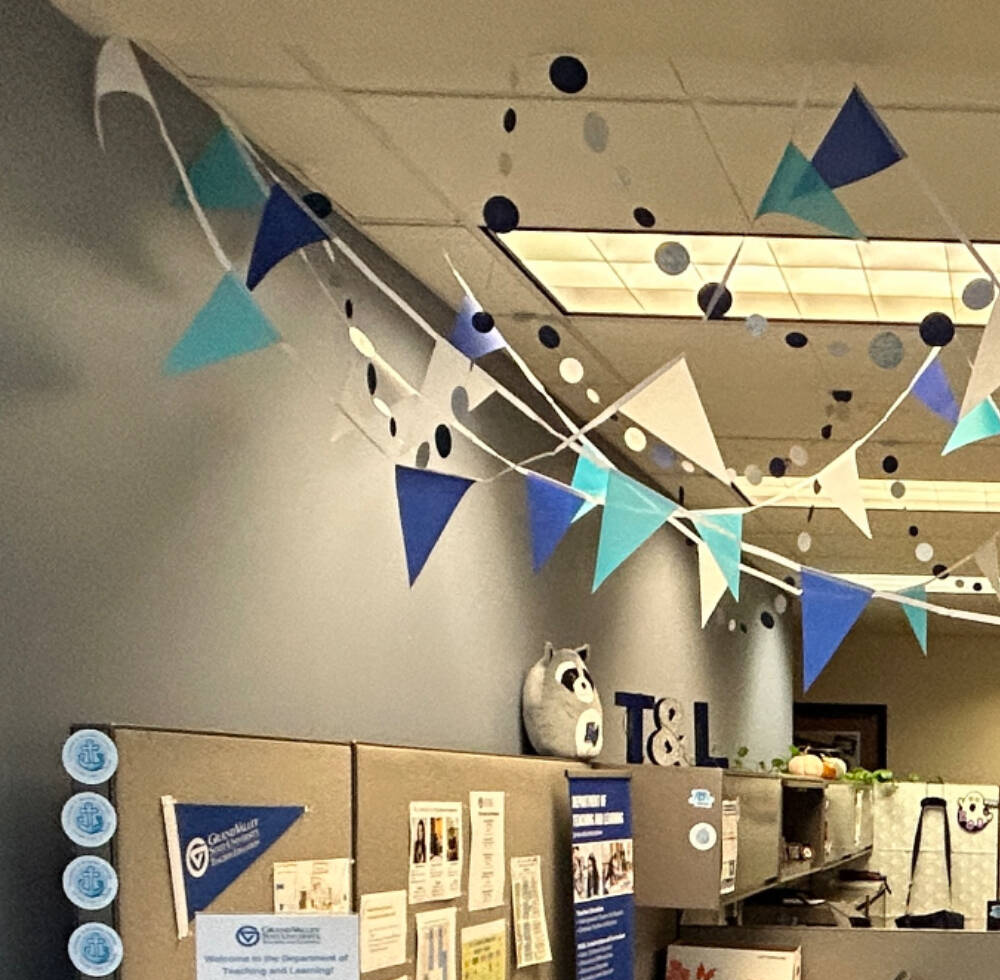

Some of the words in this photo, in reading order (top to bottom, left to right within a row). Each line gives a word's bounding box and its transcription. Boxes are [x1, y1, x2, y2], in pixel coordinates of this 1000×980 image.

[614, 691, 729, 769] T&L
[204, 954, 250, 963] Welcome
[281, 953, 336, 965] Department
[222, 966, 267, 976] Teaching
[269, 966, 288, 975] and
